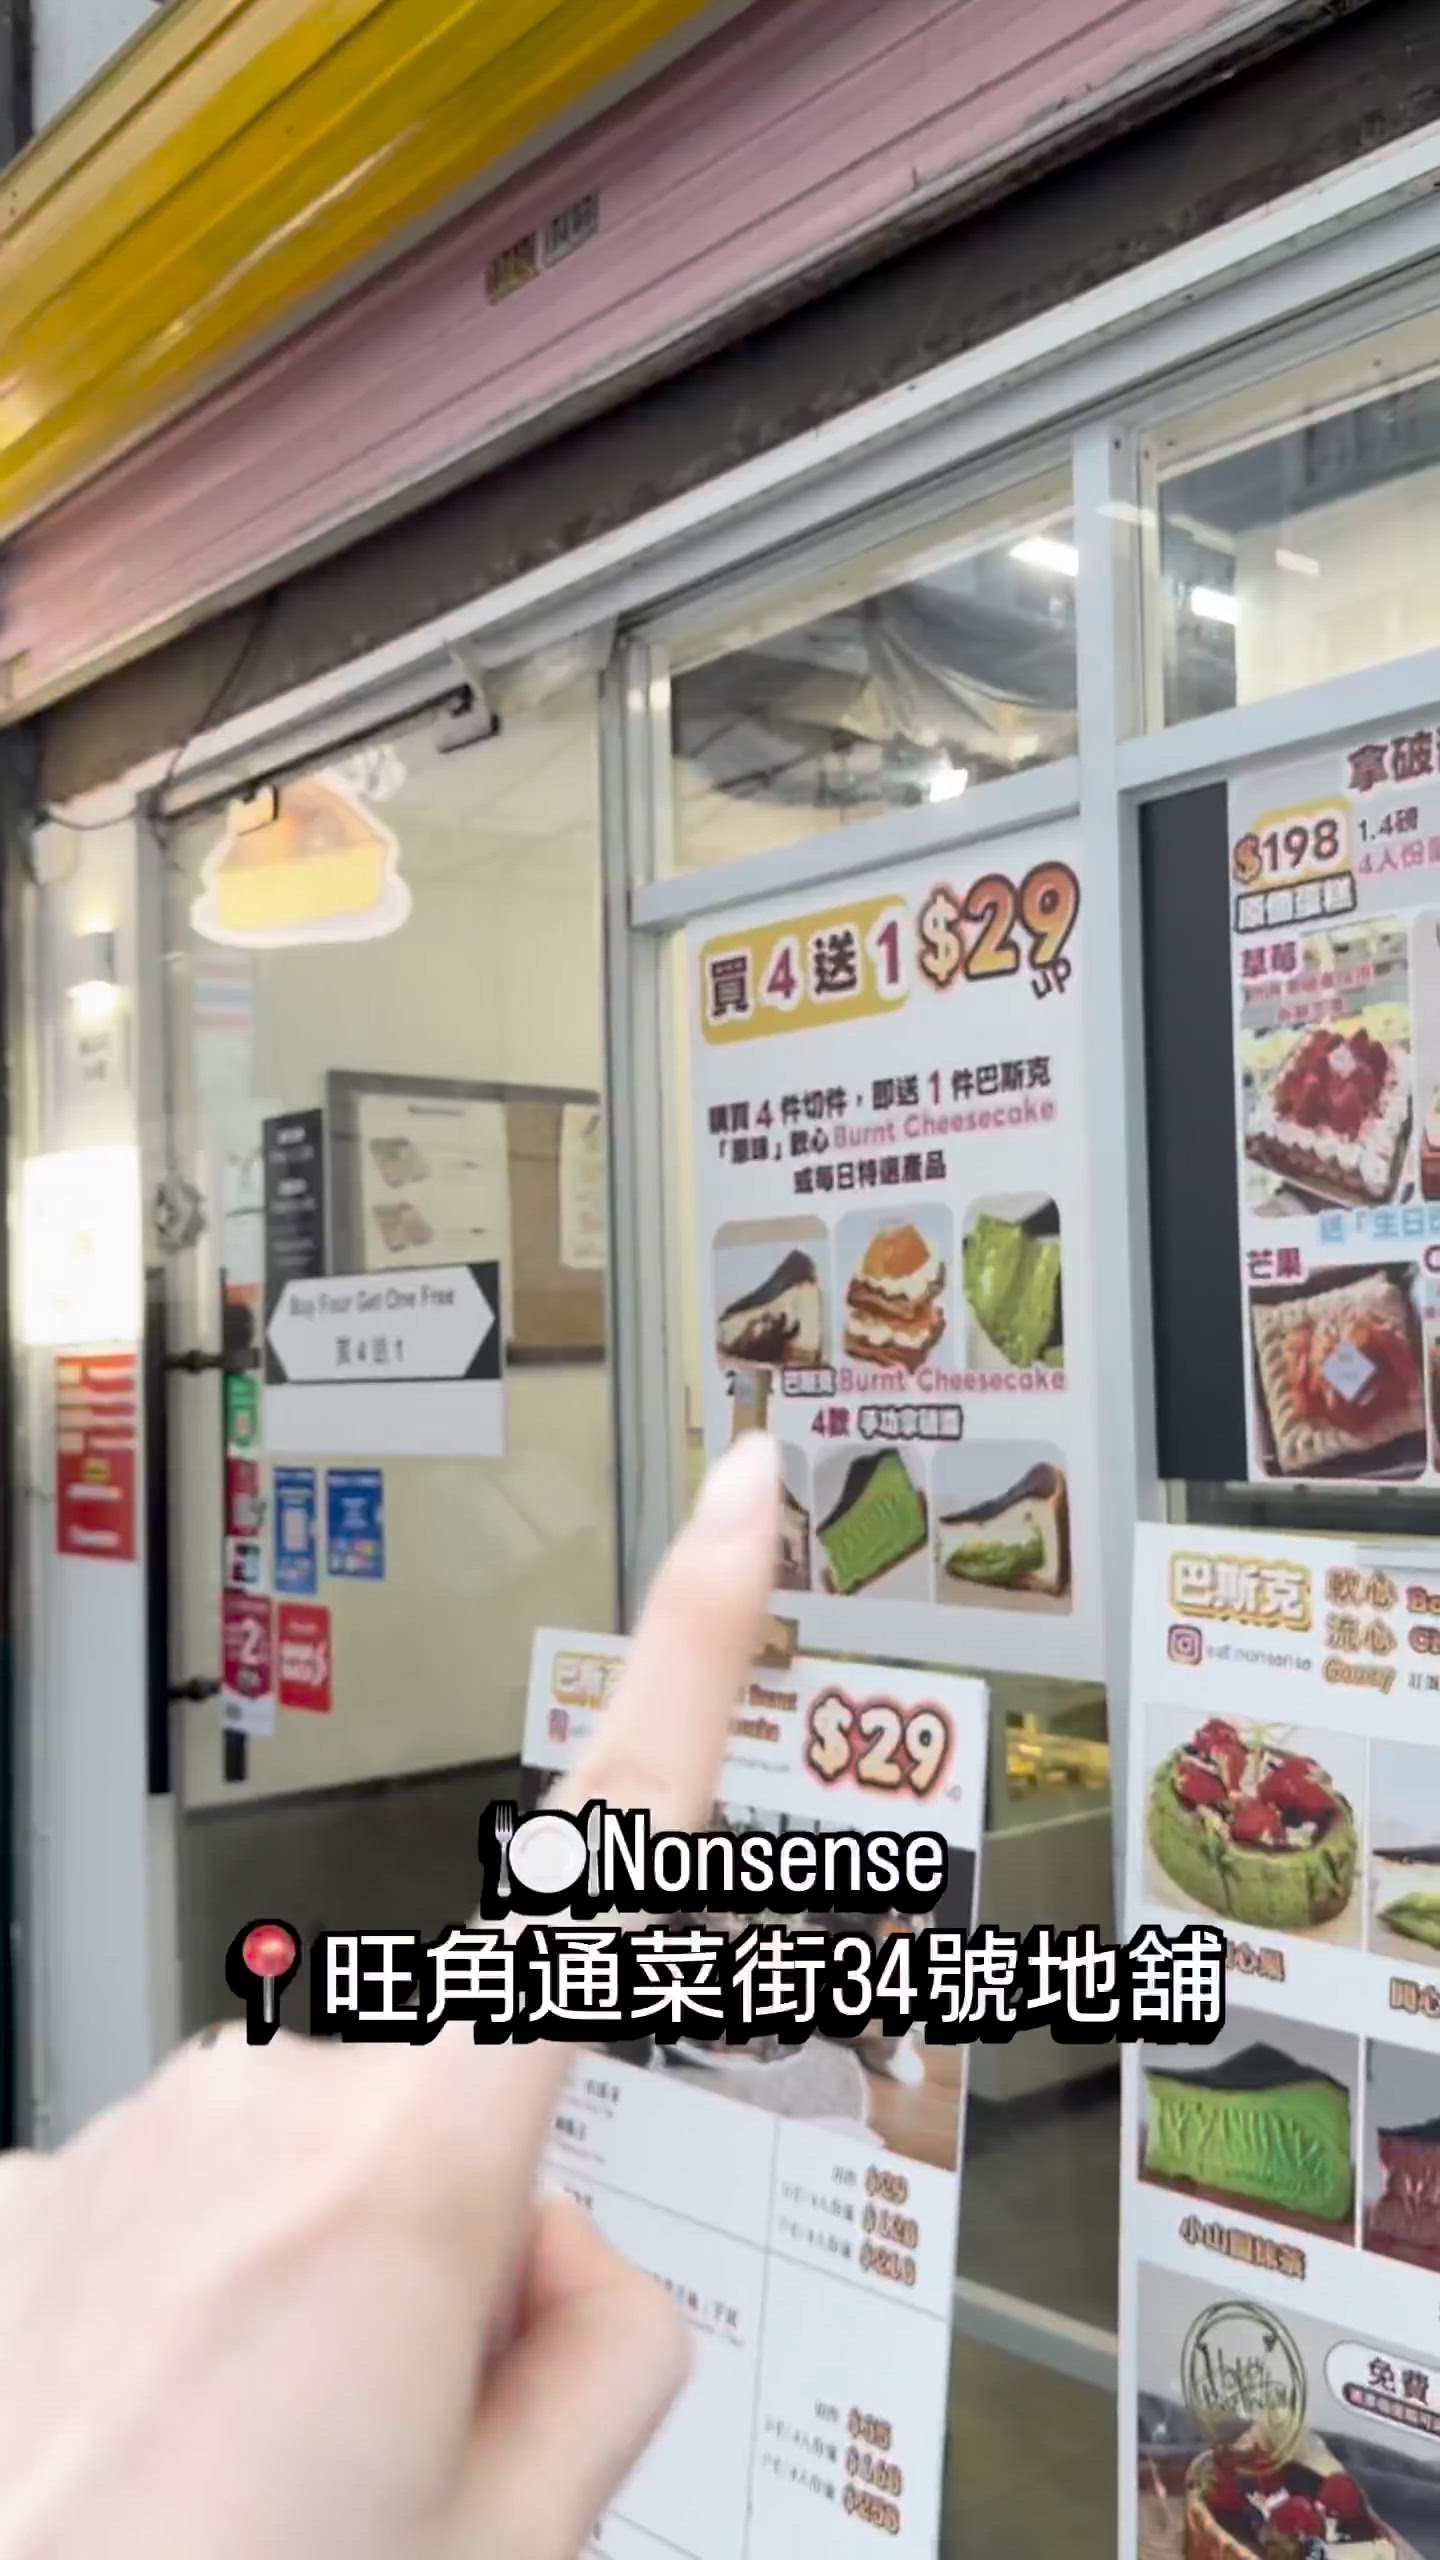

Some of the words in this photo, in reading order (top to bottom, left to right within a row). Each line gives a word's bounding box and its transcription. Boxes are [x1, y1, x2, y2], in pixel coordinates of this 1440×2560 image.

[1347, 727, 1440, 794] 拿破
[1232, 818, 1340, 885] $198
[918, 860, 1081, 990] $29
[903, 1097, 1057, 1142] Cheesecake
[839, 1369, 906, 1392] Burnt
[917, 1369, 1066, 1392] Cheesecake
[1170, 1552, 1312, 1632] 巴斯克
[806, 1689, 952, 1798] $29
